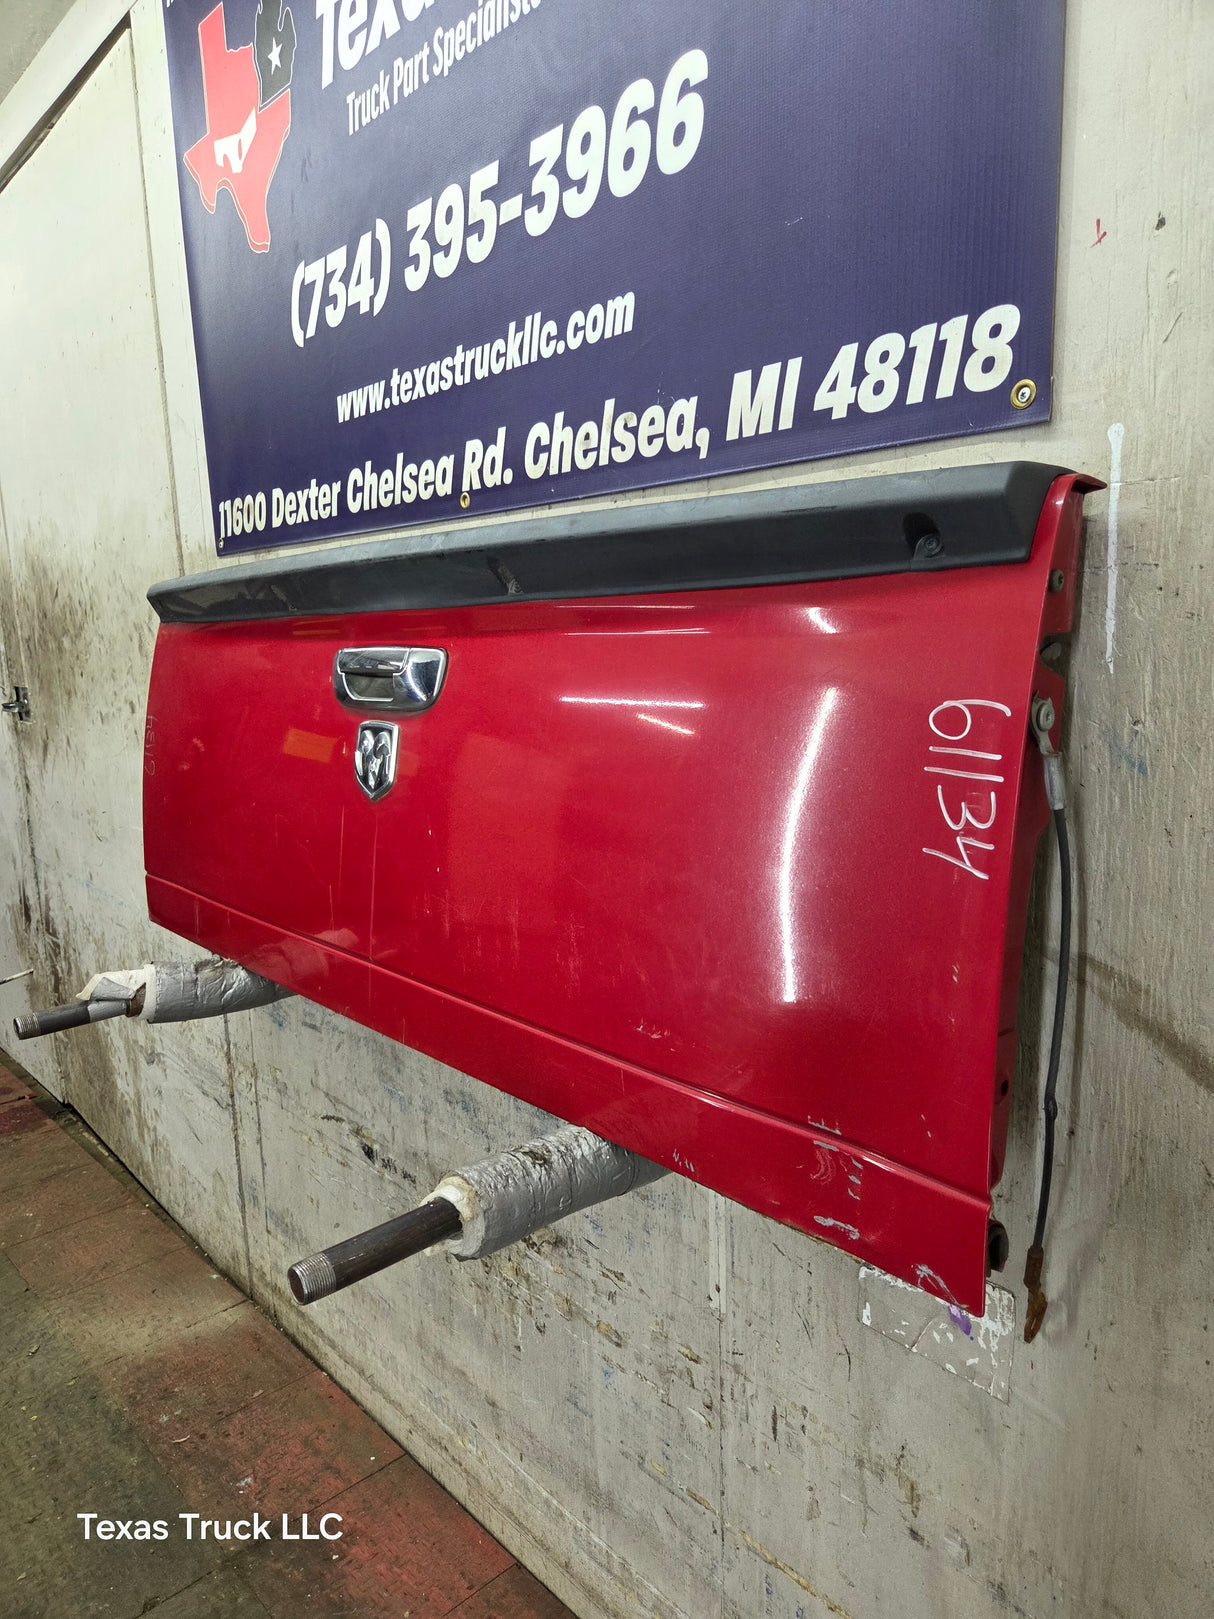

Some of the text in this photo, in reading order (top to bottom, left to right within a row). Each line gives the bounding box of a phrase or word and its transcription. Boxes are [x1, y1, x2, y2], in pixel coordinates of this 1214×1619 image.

[345, 69, 390, 136] Truck
[392, 41, 430, 105] Part
[290, 48, 709, 348] (734) 395-3966
[218, 303, 1021, 540] 11600 Dexter Chelsea Rd. Chelsea, MI 48118
[336, 292, 636, 424] www.texastruckllc.com
[923, 698, 1012, 880] 61134
